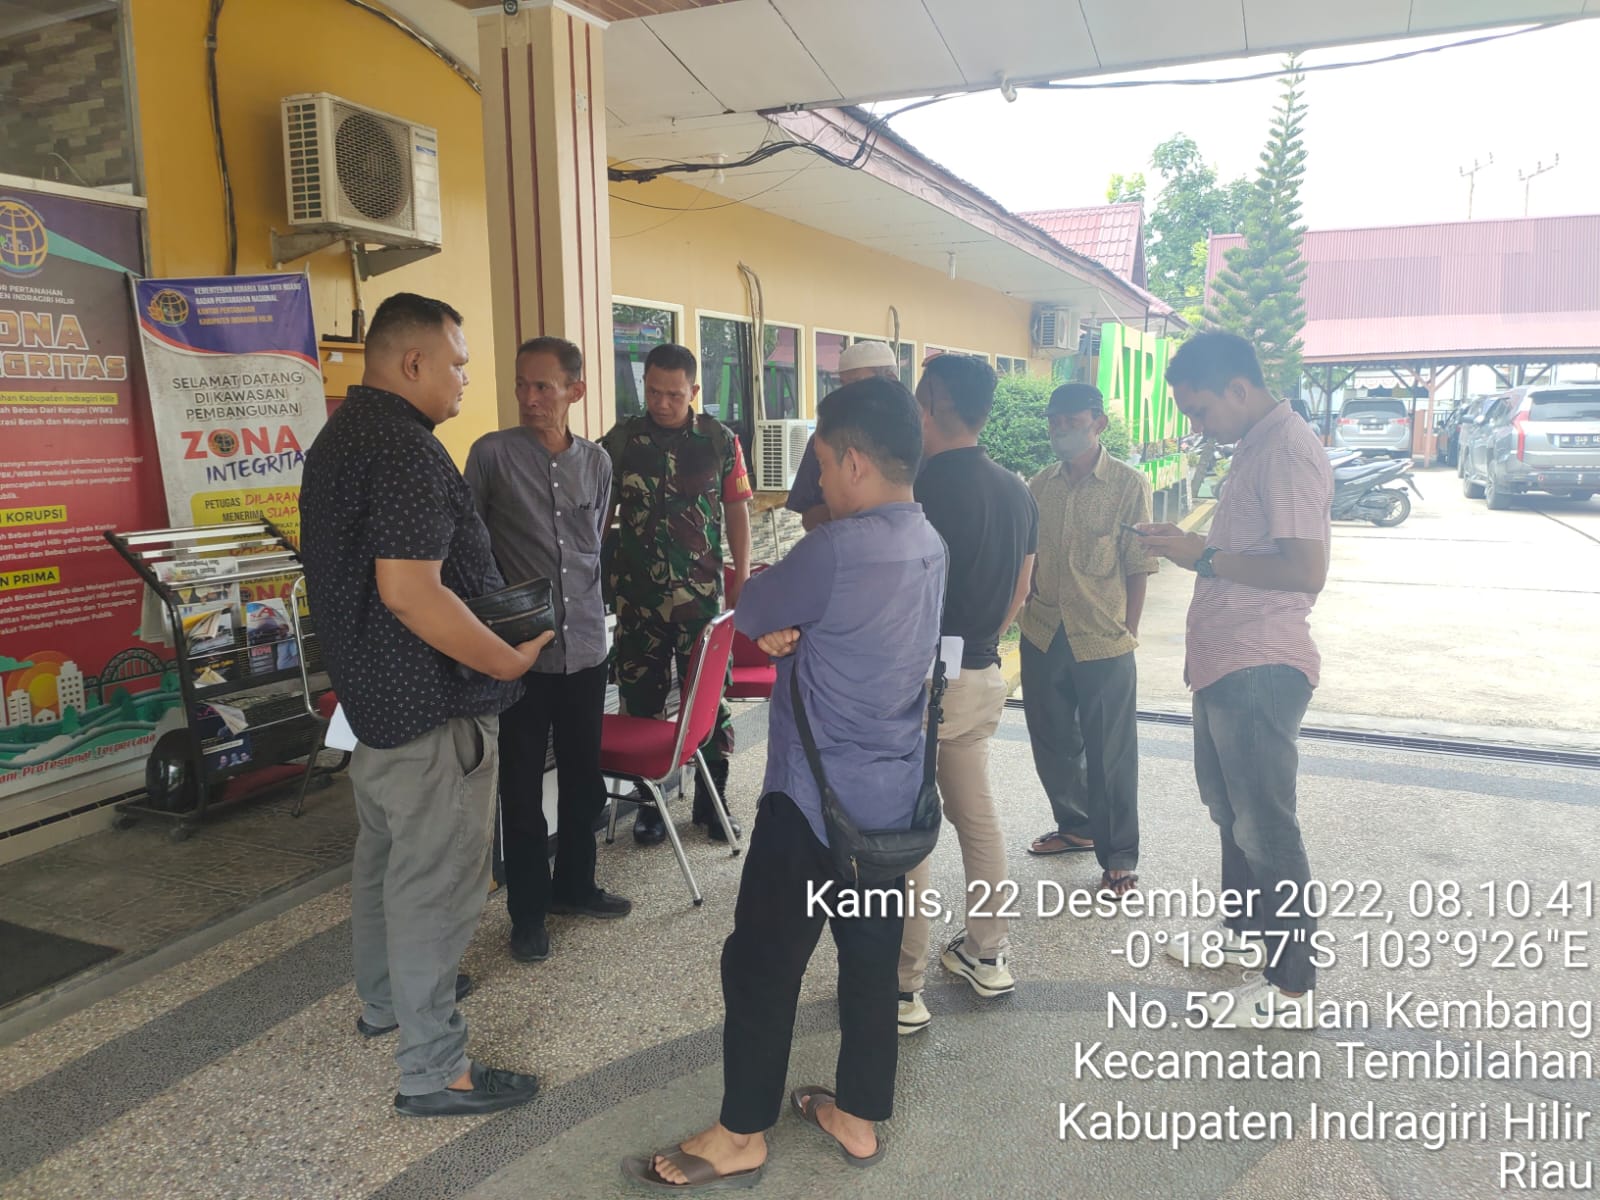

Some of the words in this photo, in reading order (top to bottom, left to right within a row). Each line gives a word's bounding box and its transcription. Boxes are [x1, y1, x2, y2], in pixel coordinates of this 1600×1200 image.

[10, 285, 63, 296] PERTANAHAN
[12, 294, 54, 303] INDRAGIRI
[0, 351, 127, 381] GRITAS
[172, 374, 238, 389] SELAMAT
[243, 371, 303, 386] DATANG
[195, 392, 210, 404] DI
[214, 388, 286, 403] KAWASAN
[186, 402, 300, 420] PEMBANGUNAN
[180, 425, 303, 460] ZONA
[206, 450, 308, 484] INTEGRITA
[204, 497, 241, 509] PETUGAS
[244, 490, 301, 506] DILARAN
[6, 508, 63, 523] KORUPSI
[222, 509, 265, 523] MENERIMA
[267, 506, 298, 519] SUAP
[13, 571, 56, 585] PRIMA
